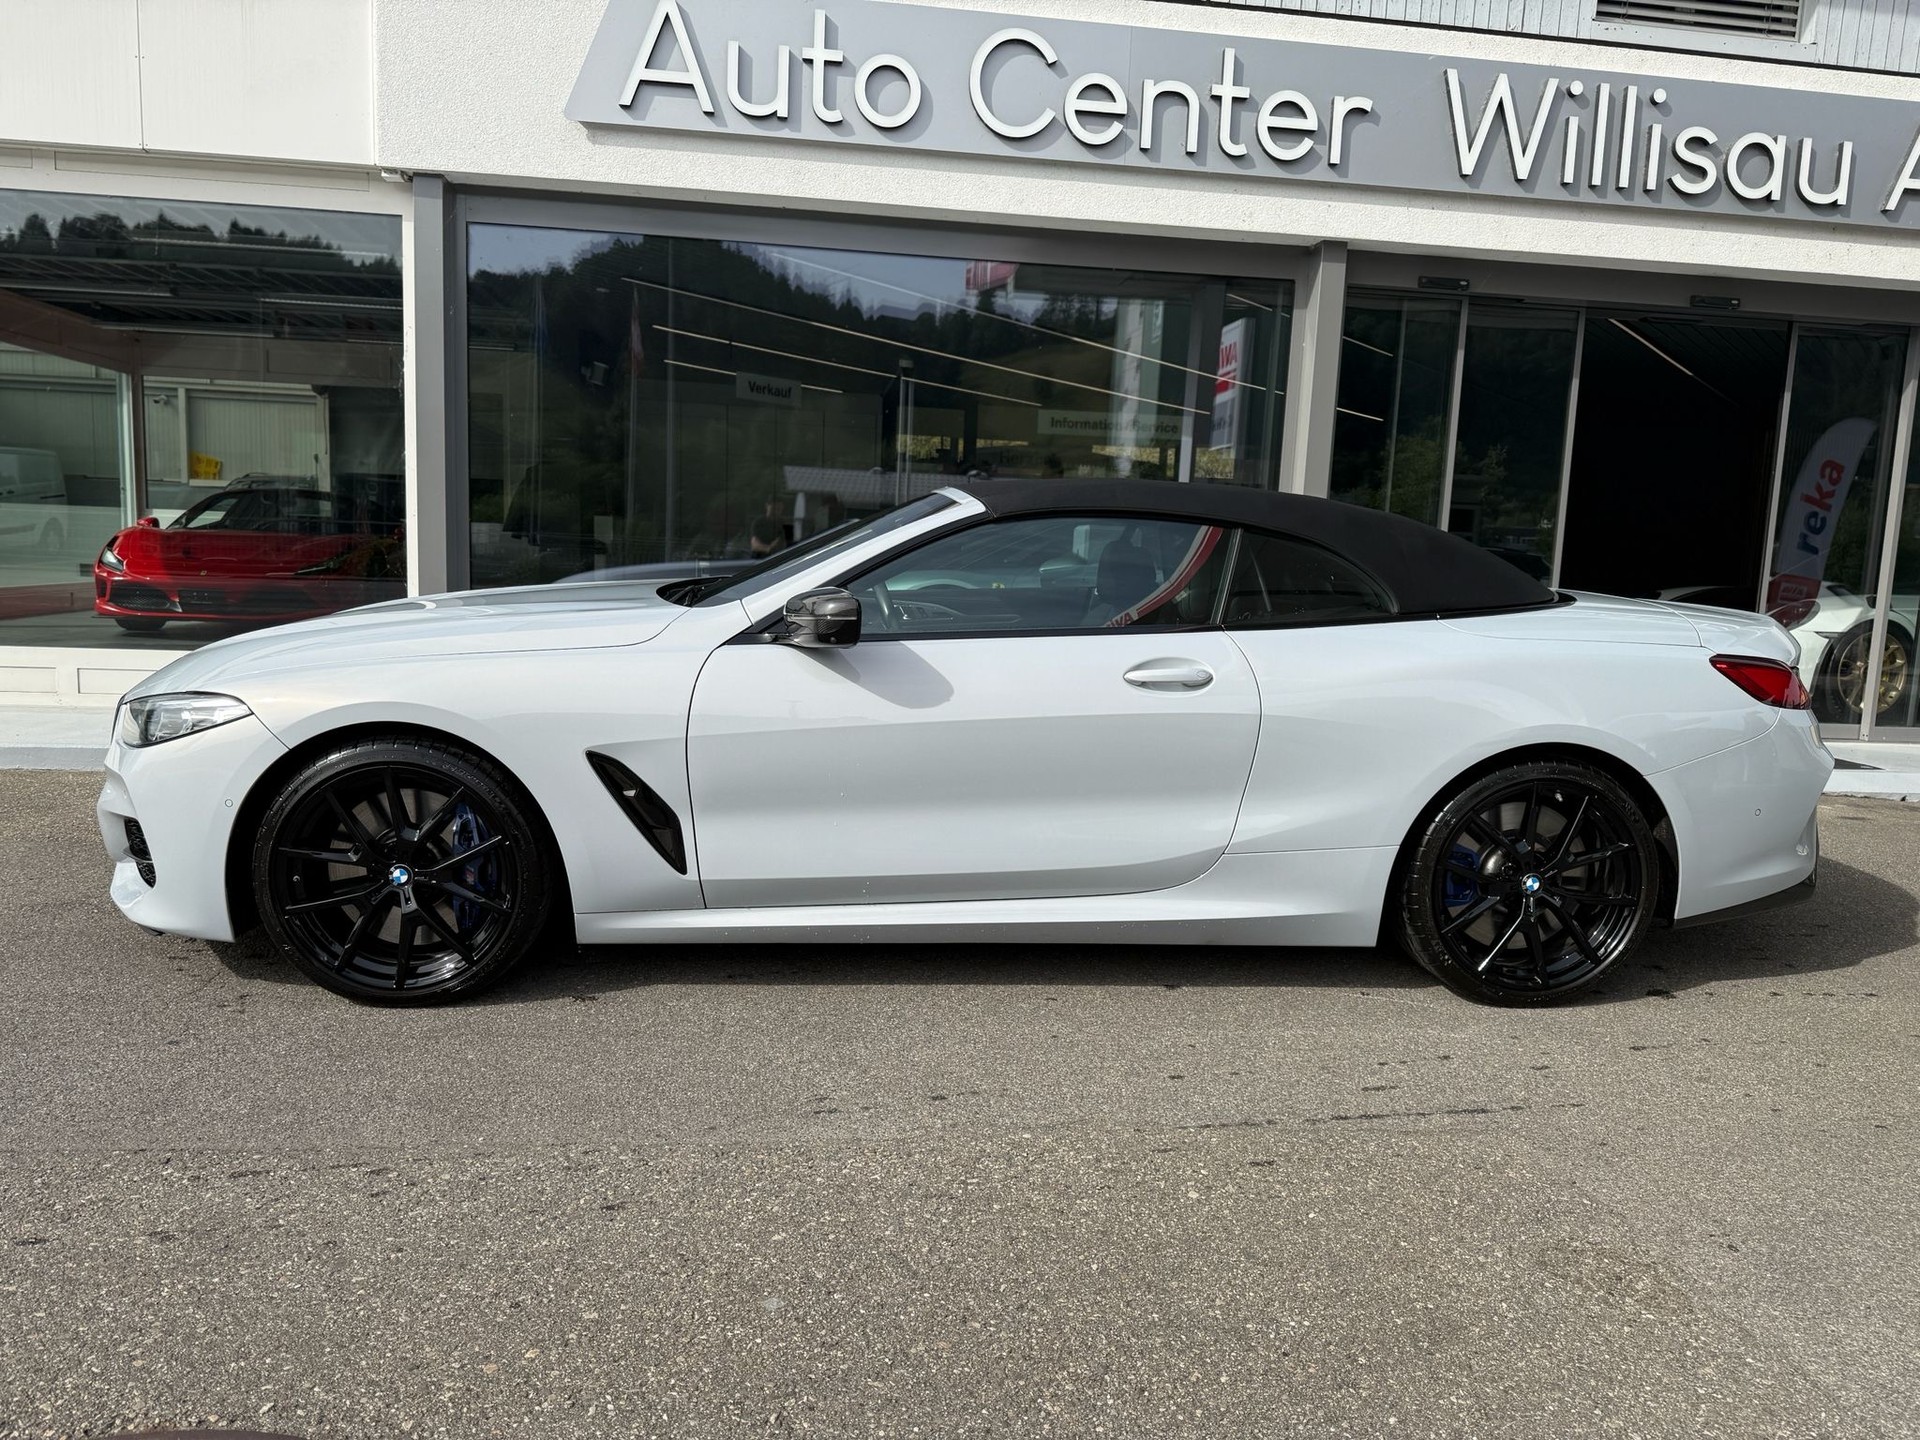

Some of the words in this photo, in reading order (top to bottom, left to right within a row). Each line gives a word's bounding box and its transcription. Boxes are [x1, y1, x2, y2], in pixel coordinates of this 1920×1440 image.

[618, 0, 922, 128] Auto
[968, 27, 1373, 166] Center
[1443, 67, 1853, 206] Willisau
[748, 380, 792, 398] Verkauf
[1796, 458, 1847, 556] reka
